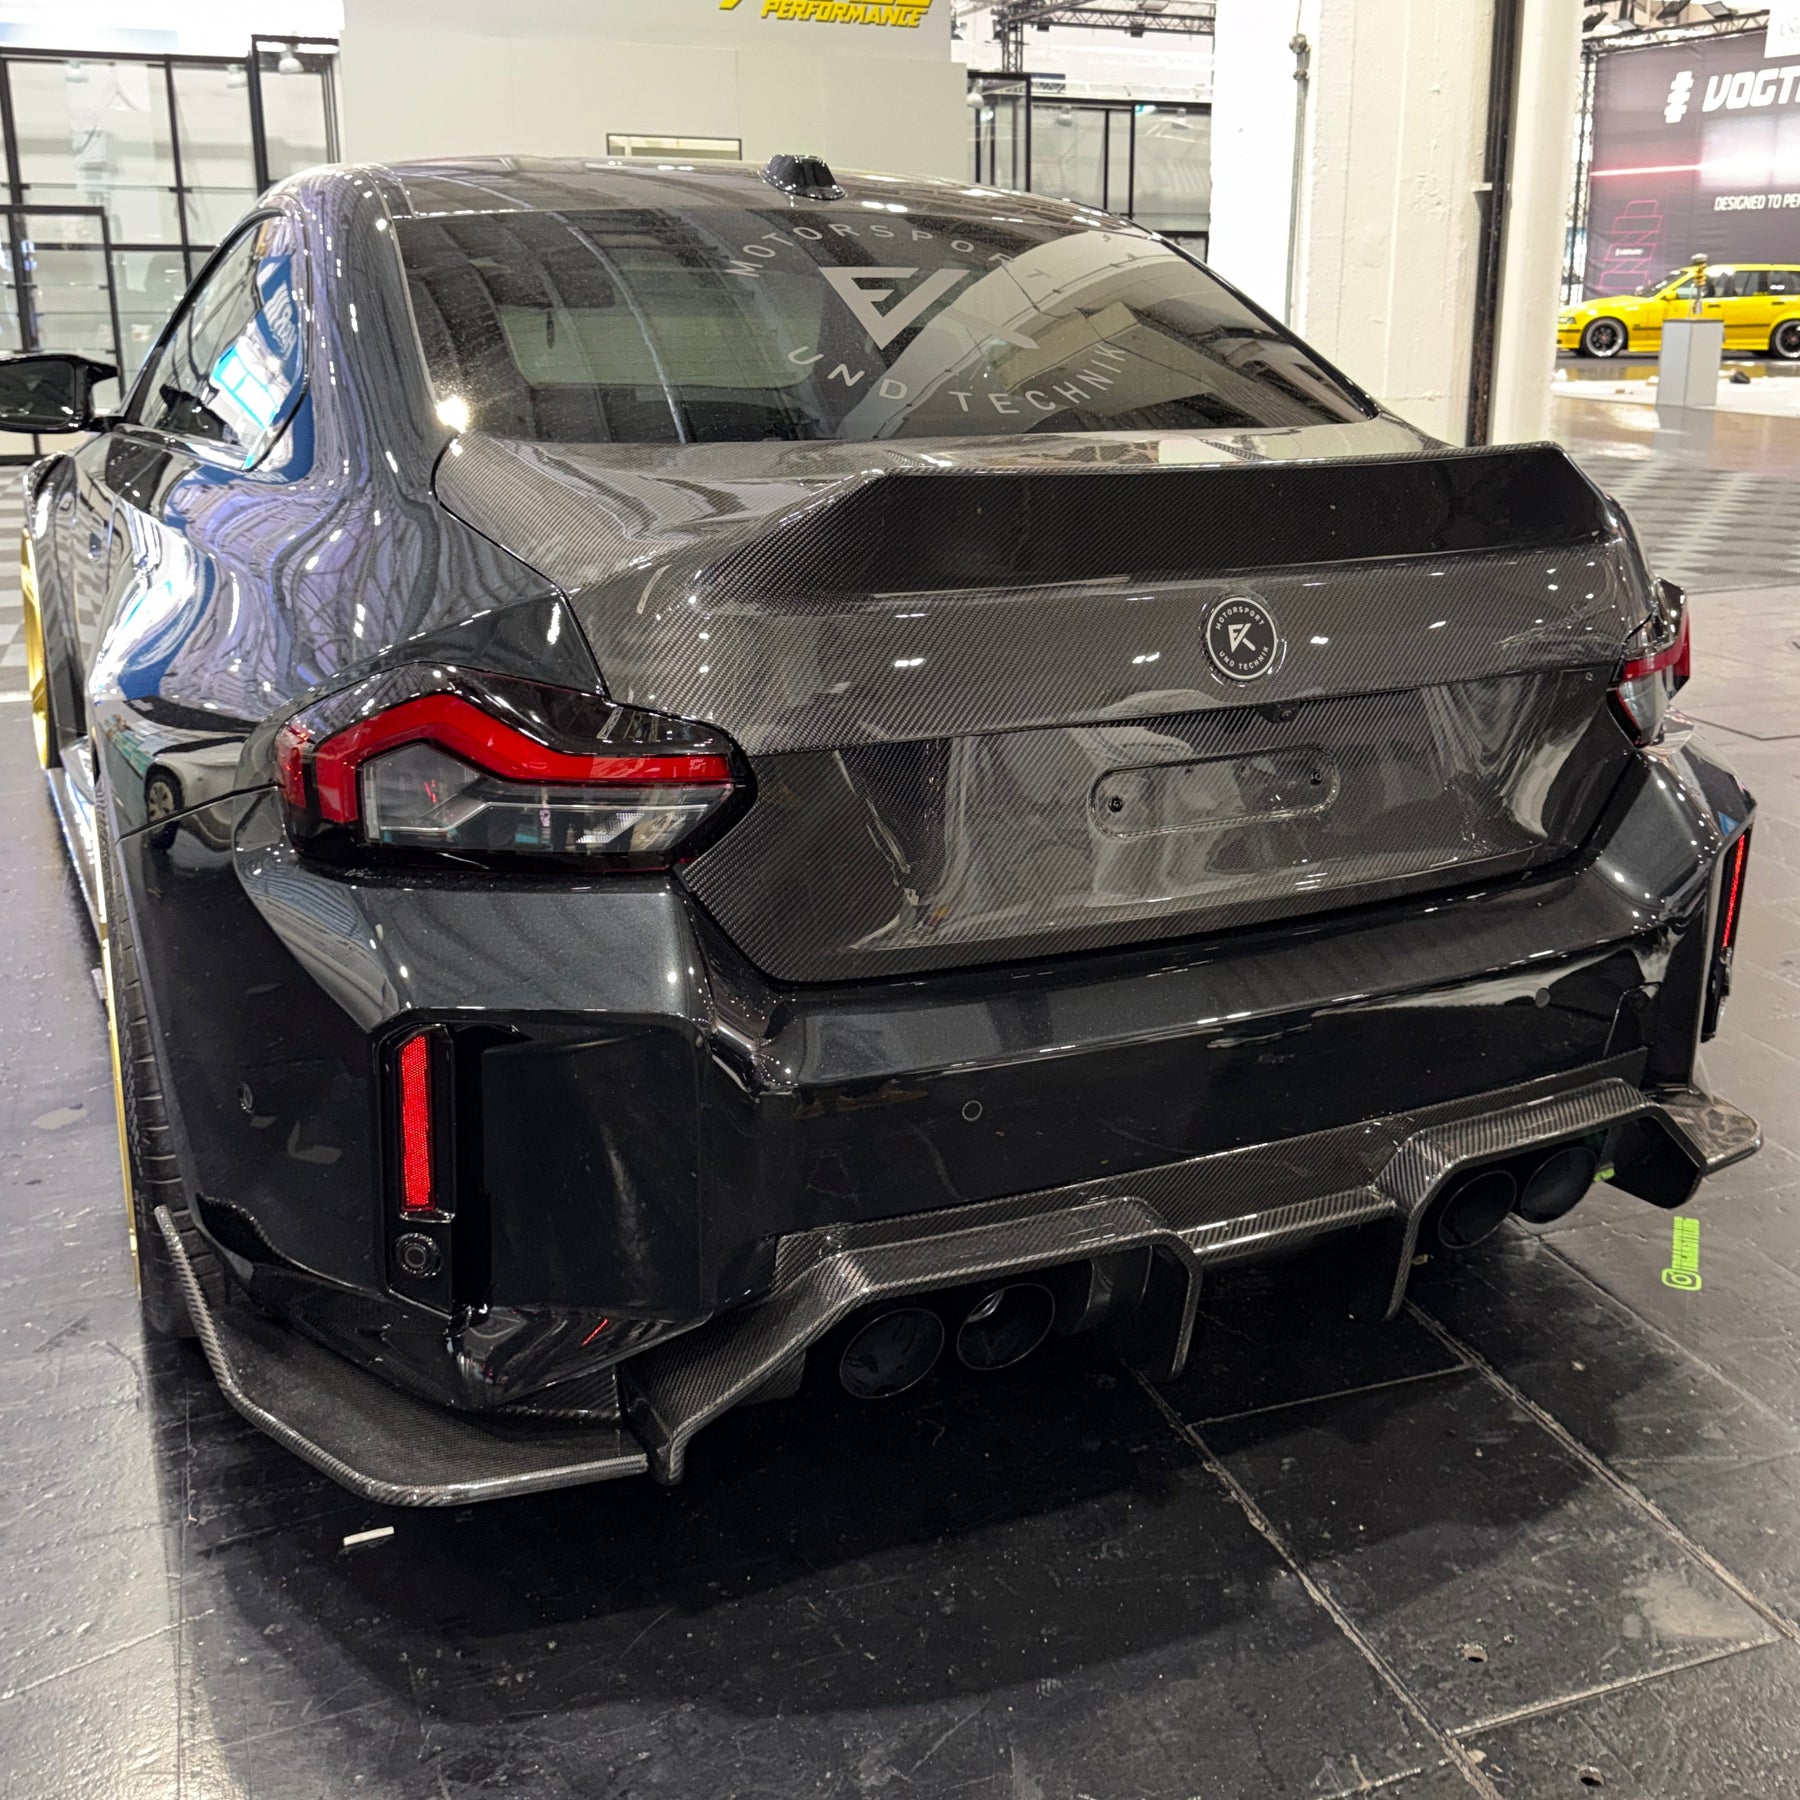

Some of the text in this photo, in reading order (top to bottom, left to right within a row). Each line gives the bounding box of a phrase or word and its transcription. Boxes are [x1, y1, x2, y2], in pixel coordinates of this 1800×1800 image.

[761, 0, 928, 27] PERFORMANCE
[1702, 65, 1800, 112] VOGT
[1714, 194, 1766, 211] DESIGNED
[1767, 194, 1783, 209] TO
[787, 344, 1127, 415] UND TECHNIK
[1216, 607, 1264, 630] MOTORSPORT
[1220, 647, 1269, 670] UND TECHNIK
